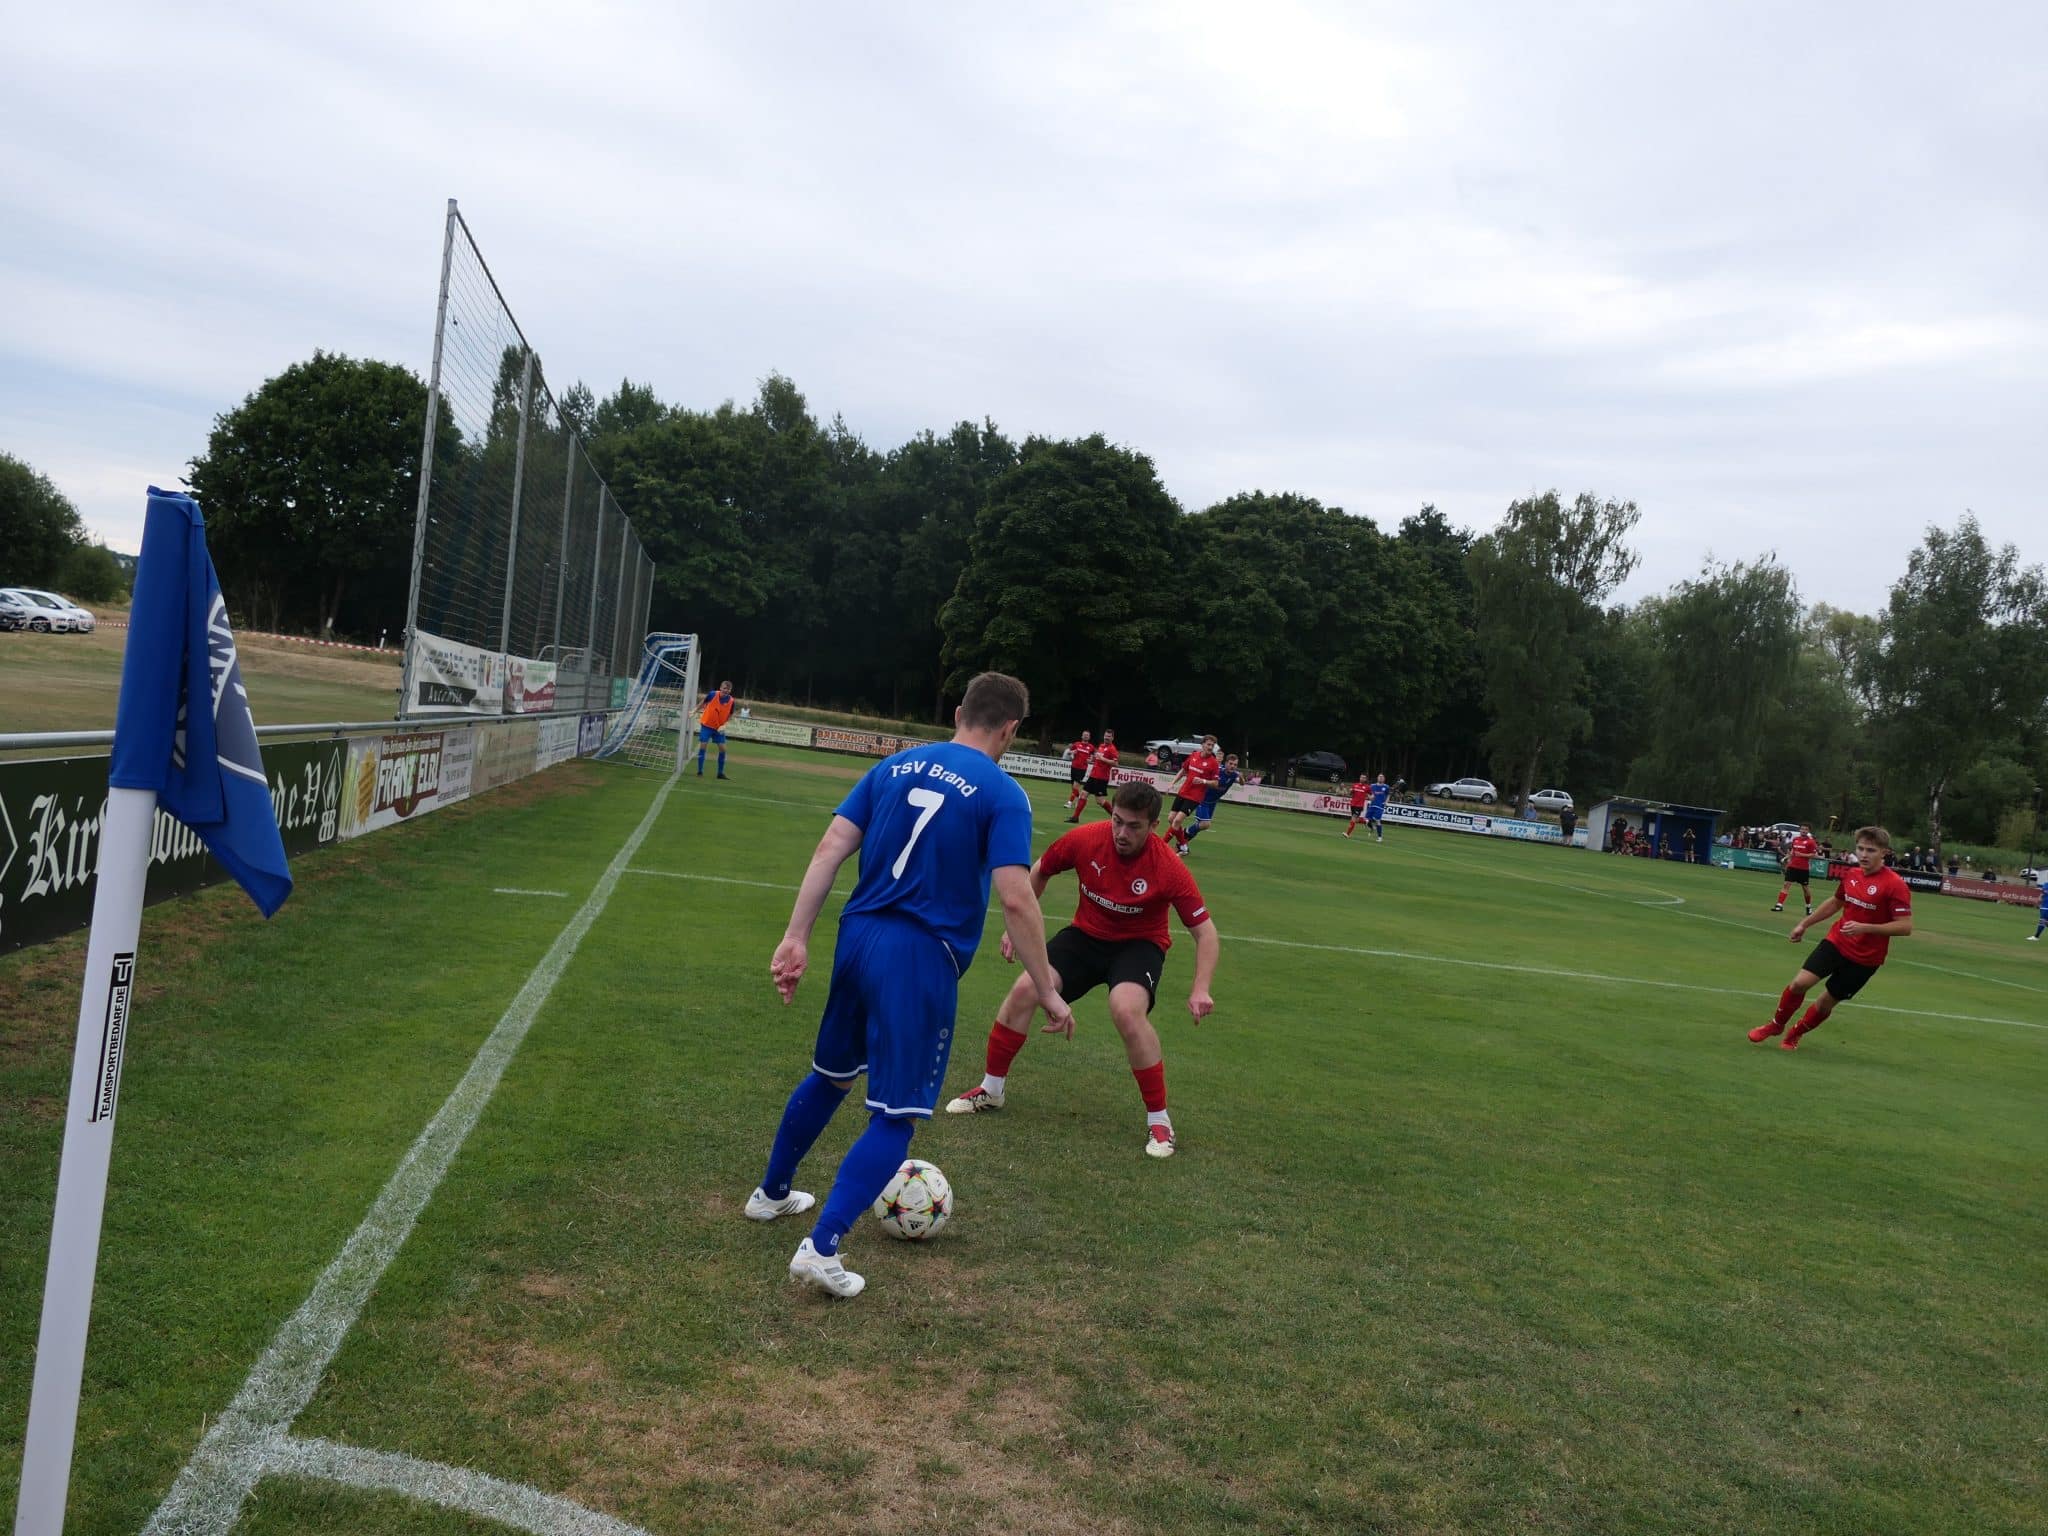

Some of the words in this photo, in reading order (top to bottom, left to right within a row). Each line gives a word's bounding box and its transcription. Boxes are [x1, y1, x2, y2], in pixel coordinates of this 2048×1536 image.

[891, 760, 927, 778] TSV
[927, 763, 979, 799] Brand
[1111, 769, 1155, 785] PRÜTTING
[1323, 796, 1351, 810] PRÜTT
[1401, 808, 1416, 818] Car
[1417, 810, 1448, 822] Service
[1450, 814, 1471, 825] Haas
[891, 787, 945, 881] 7
[99, 986, 128, 1121] TEAMSPORTBEDARF.DE
